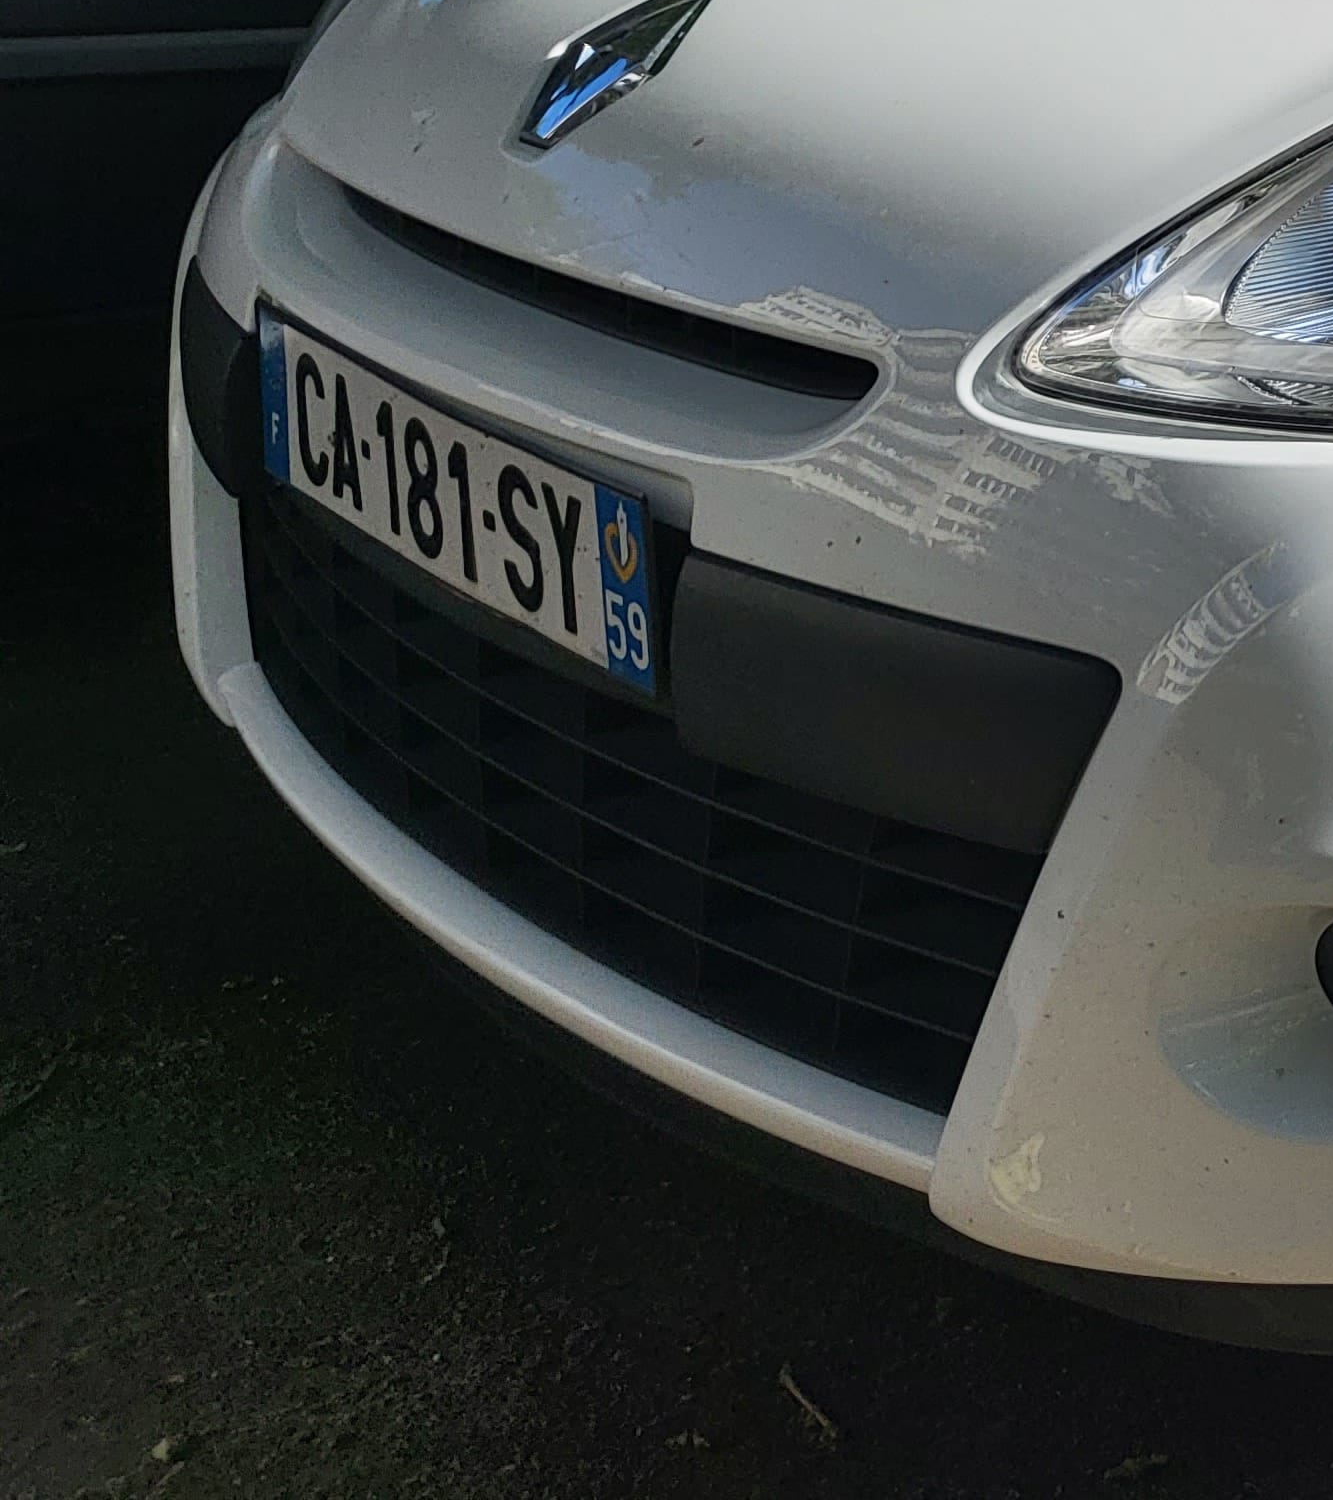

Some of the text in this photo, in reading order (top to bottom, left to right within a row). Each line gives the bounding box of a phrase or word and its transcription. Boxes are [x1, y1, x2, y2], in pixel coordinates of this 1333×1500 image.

[271, 411, 281, 445] F
[295, 352, 582, 636] CA-181-SY
[604, 589, 651, 671] 59
